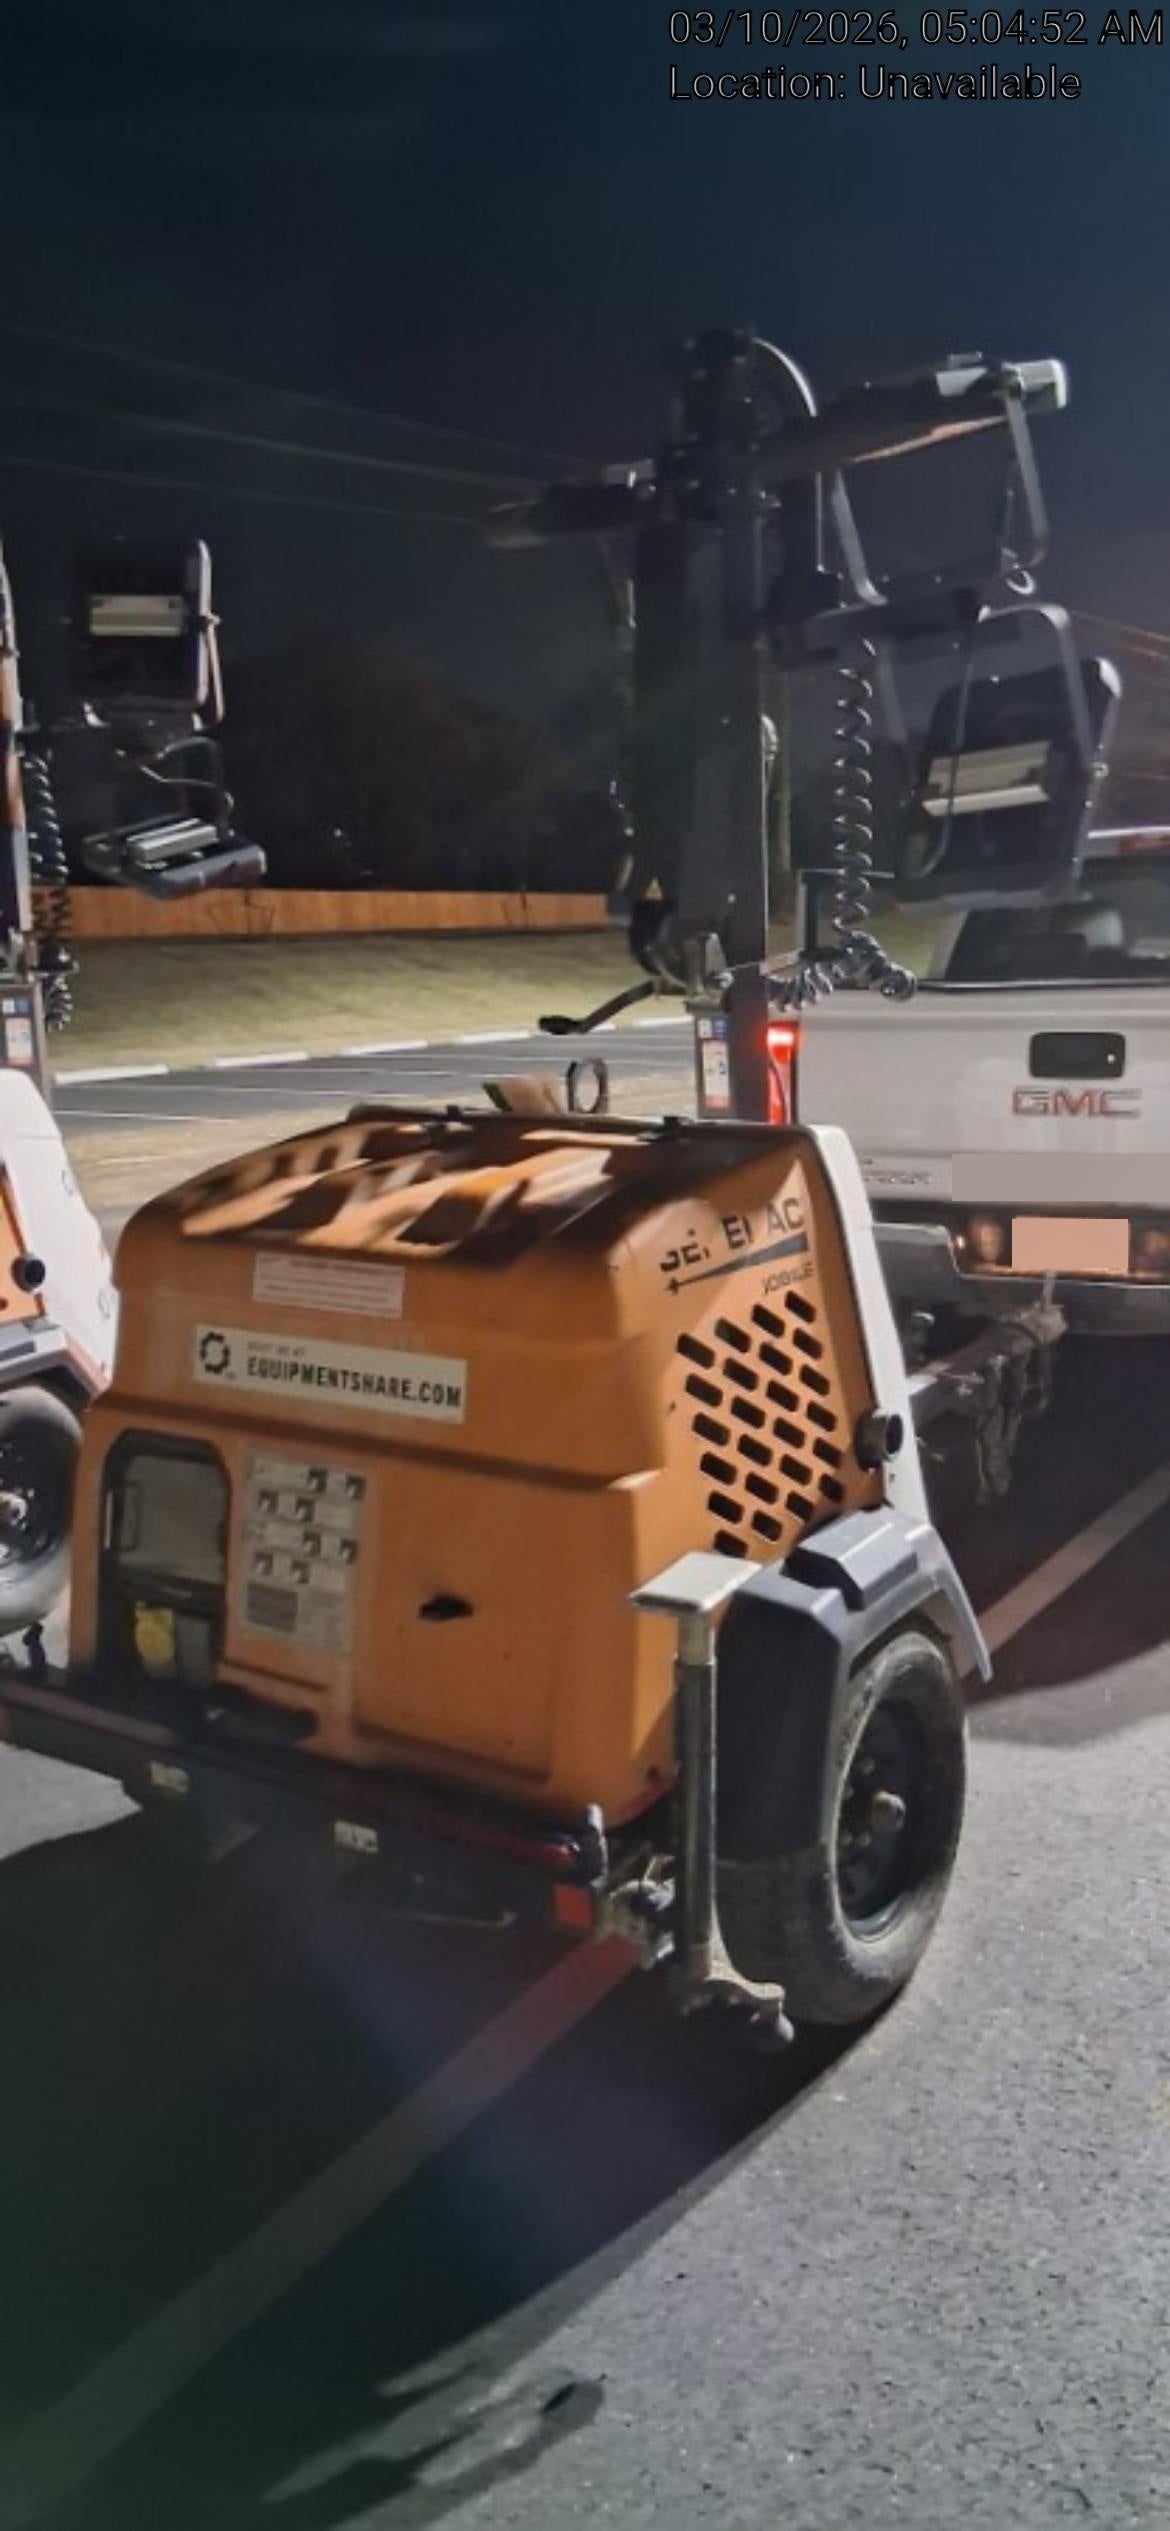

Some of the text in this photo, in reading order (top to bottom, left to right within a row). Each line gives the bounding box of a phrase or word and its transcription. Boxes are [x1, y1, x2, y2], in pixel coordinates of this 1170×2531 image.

[1012, 1088, 1142, 1118] GMC
[659, 1198, 805, 1273] EEAC
[246, 1356, 461, 1407] EQUIPMENTSHARE.COM
